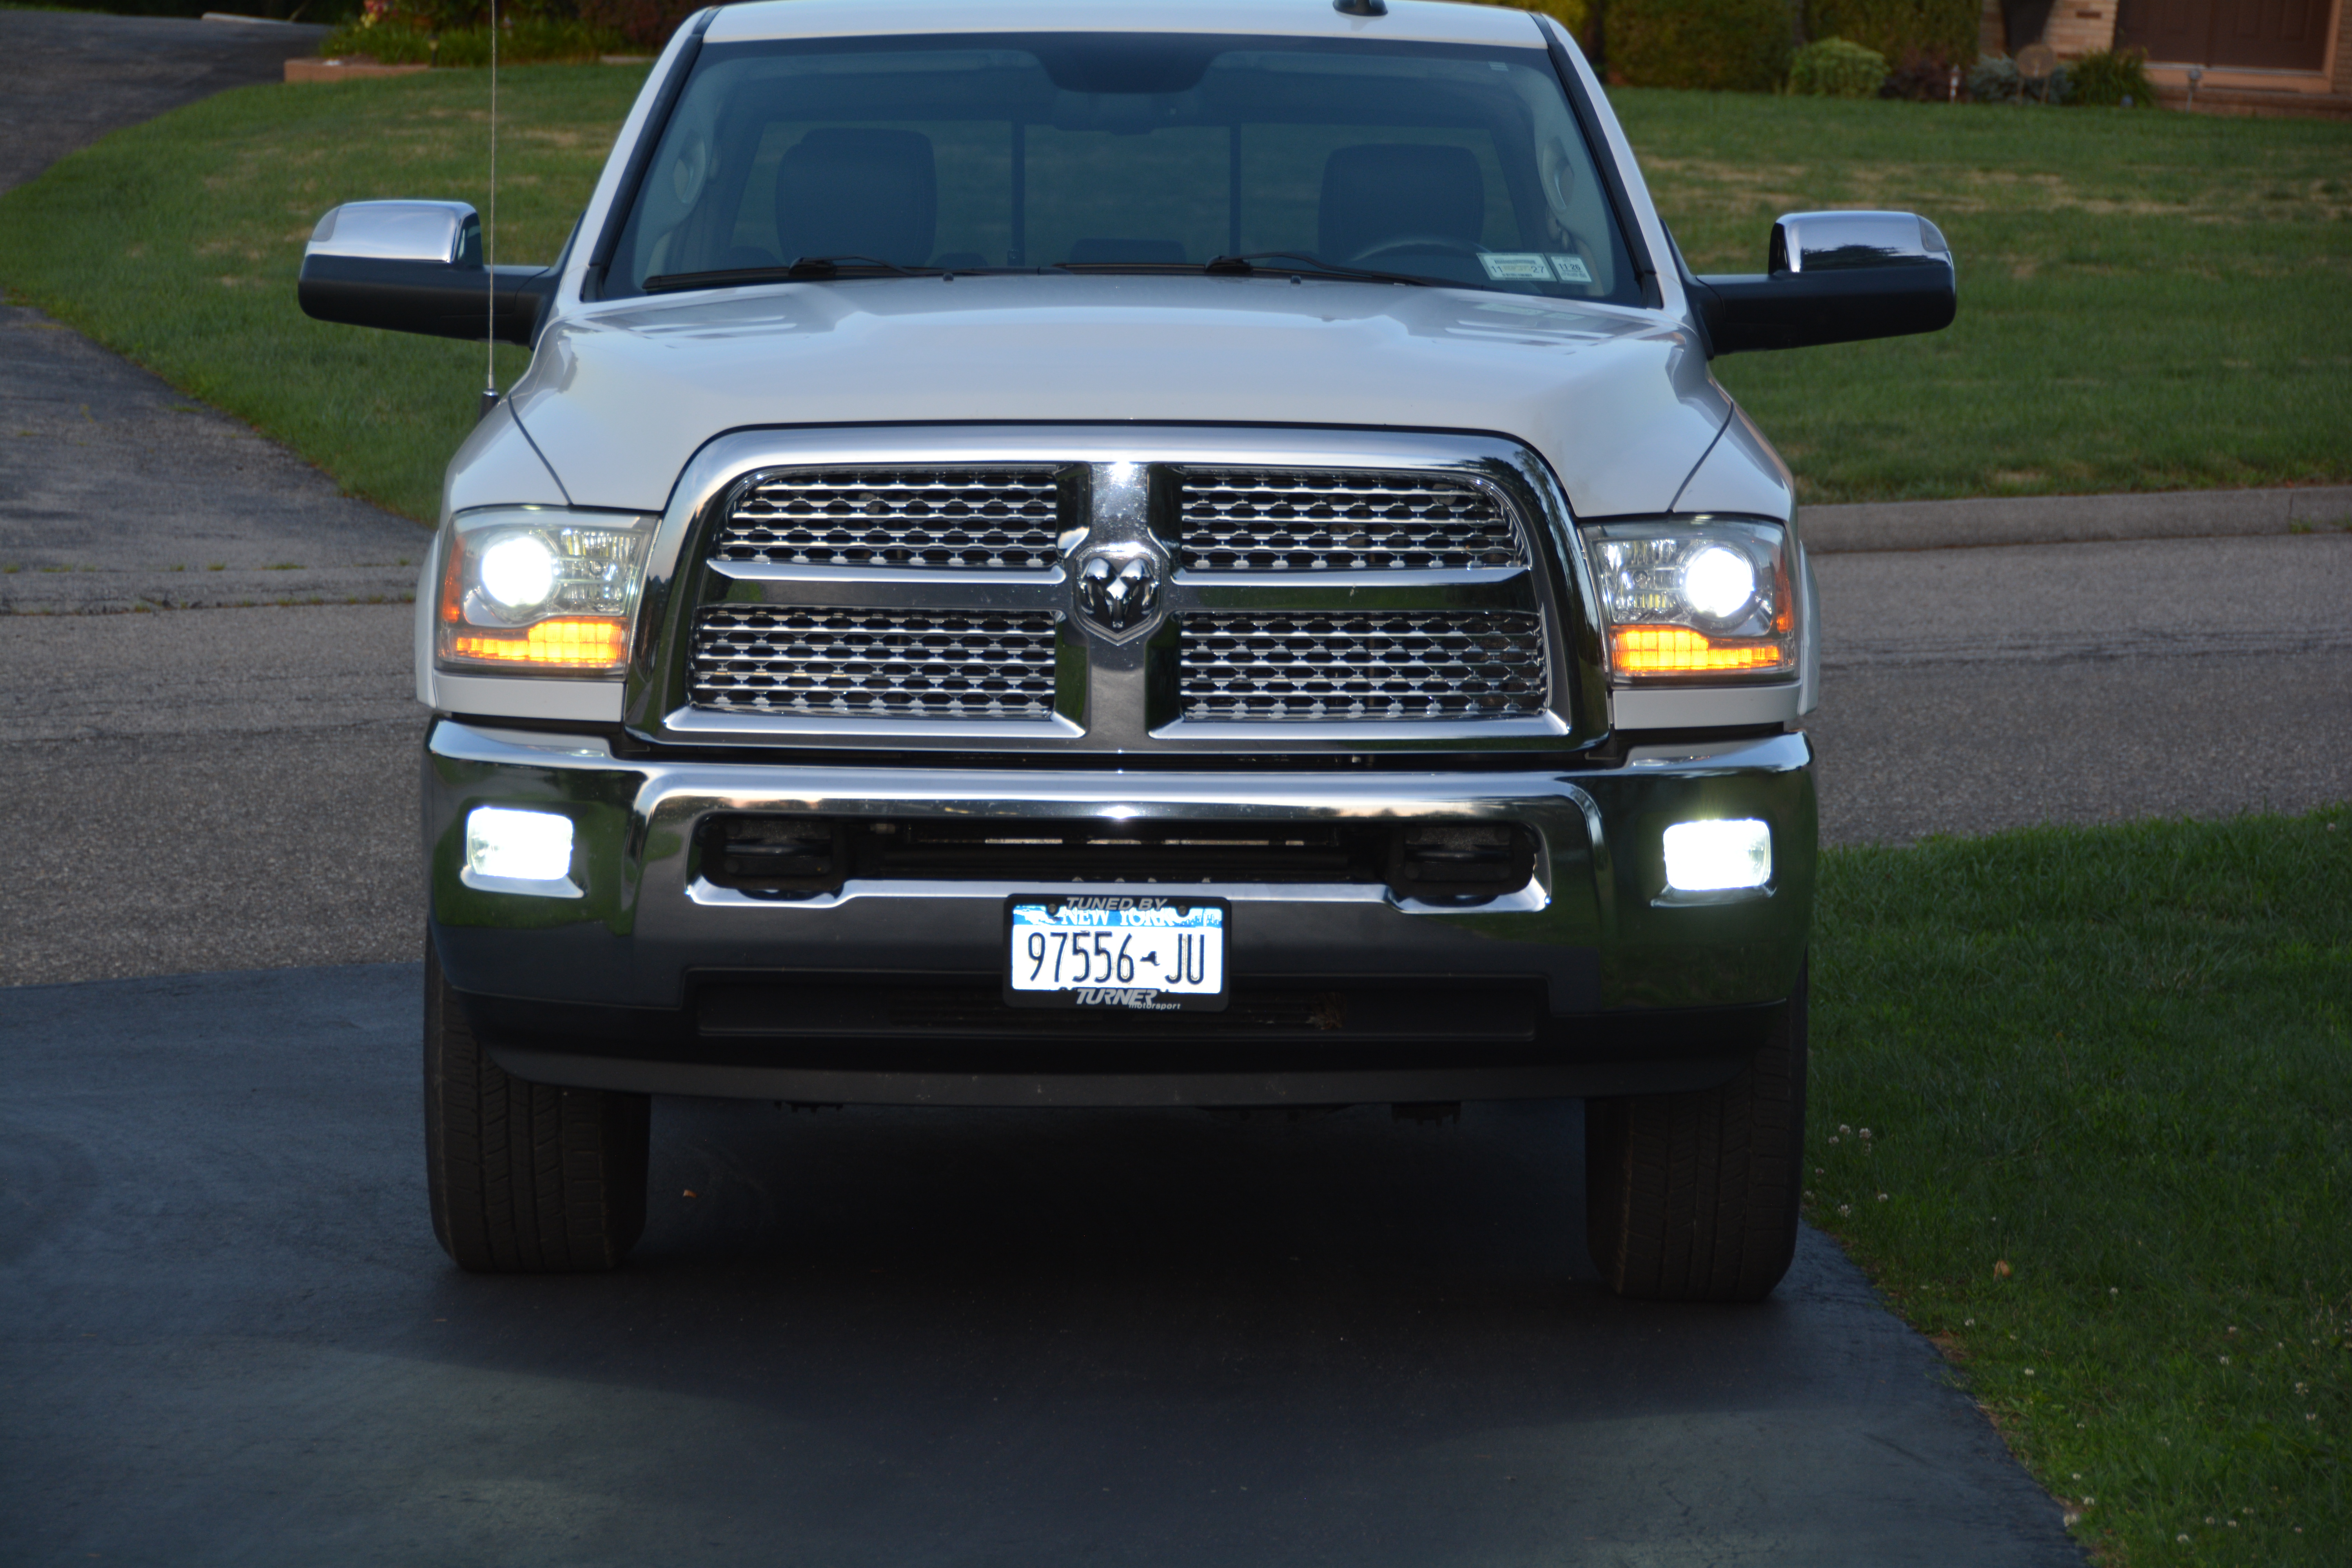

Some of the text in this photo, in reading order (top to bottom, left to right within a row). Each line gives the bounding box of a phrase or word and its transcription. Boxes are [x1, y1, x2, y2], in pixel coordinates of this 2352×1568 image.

[1067, 897, 1168, 910] TUNED BY
[1061, 908, 1174, 926] NEW YORK
[1028, 931, 1205, 984] 97556 JU
[1076, 988, 1157, 1005] TURNER
